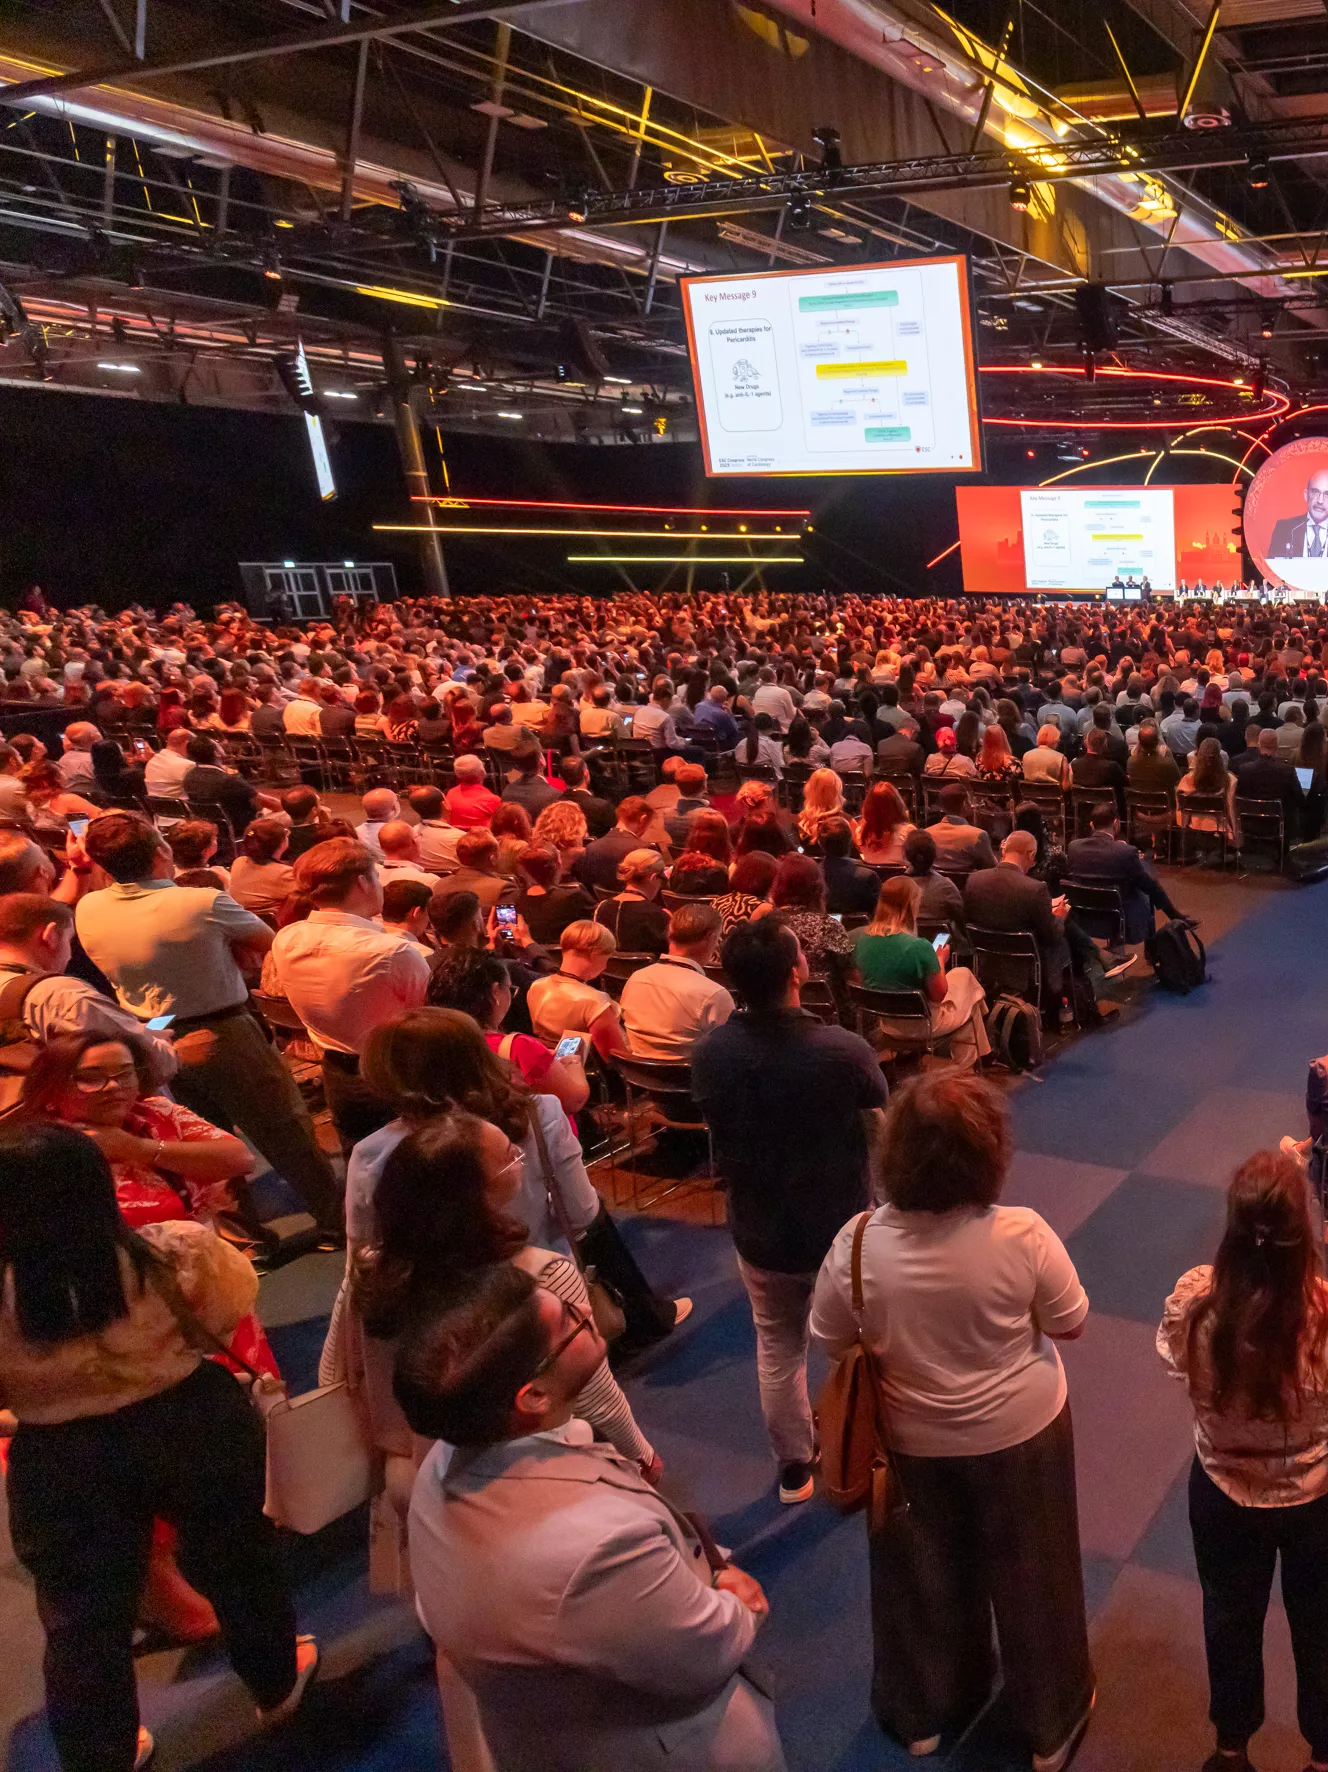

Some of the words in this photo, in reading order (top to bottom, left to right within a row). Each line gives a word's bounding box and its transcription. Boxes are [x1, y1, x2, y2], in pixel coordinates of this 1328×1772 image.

[704, 293, 717, 303] Key
[719, 291, 750, 301] Message
[752, 290, 757, 298] 9
[716, 327, 737, 335] Updated
[739, 326, 762, 334] therapies
